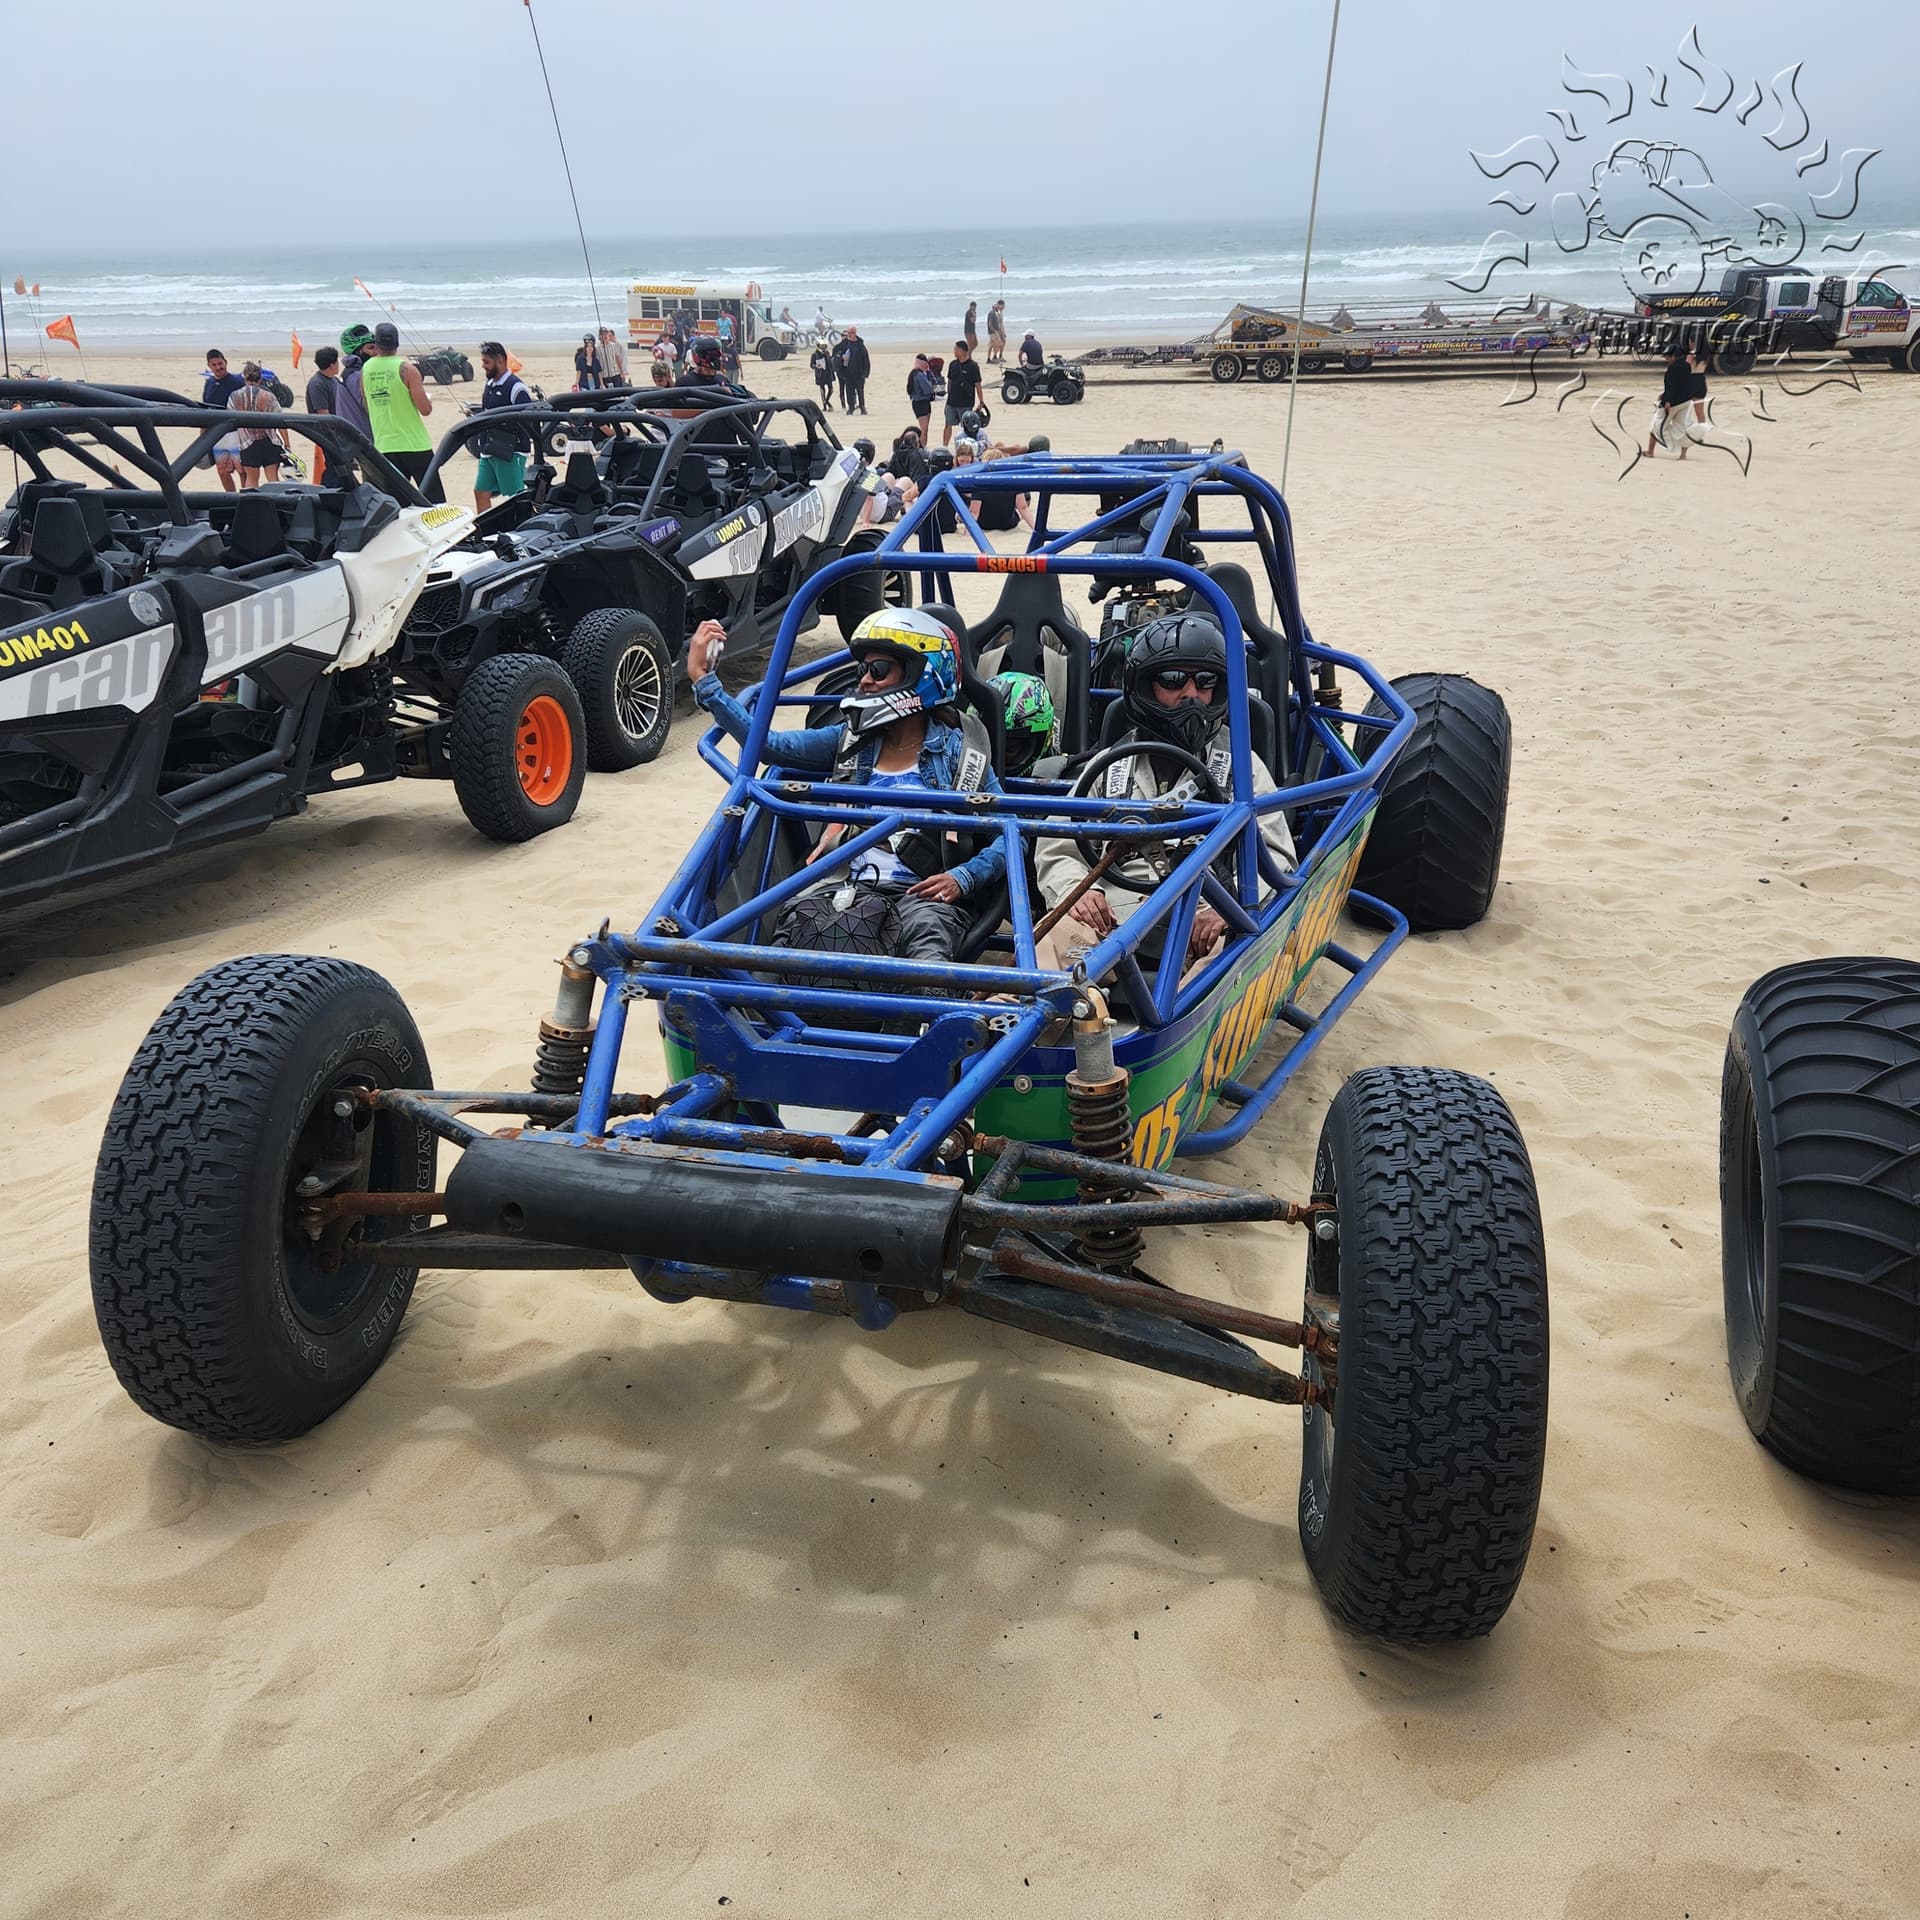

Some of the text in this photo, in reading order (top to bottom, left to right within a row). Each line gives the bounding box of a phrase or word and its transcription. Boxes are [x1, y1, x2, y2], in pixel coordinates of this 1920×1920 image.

[650, 519, 677, 544] RENT ME
[715, 515, 747, 544] UM001
[987, 556, 1036, 573] SB405
[895, 695, 922, 711] MARVEL
[960, 761, 977, 792] CROW
[1109, 765, 1122, 794] CROW
